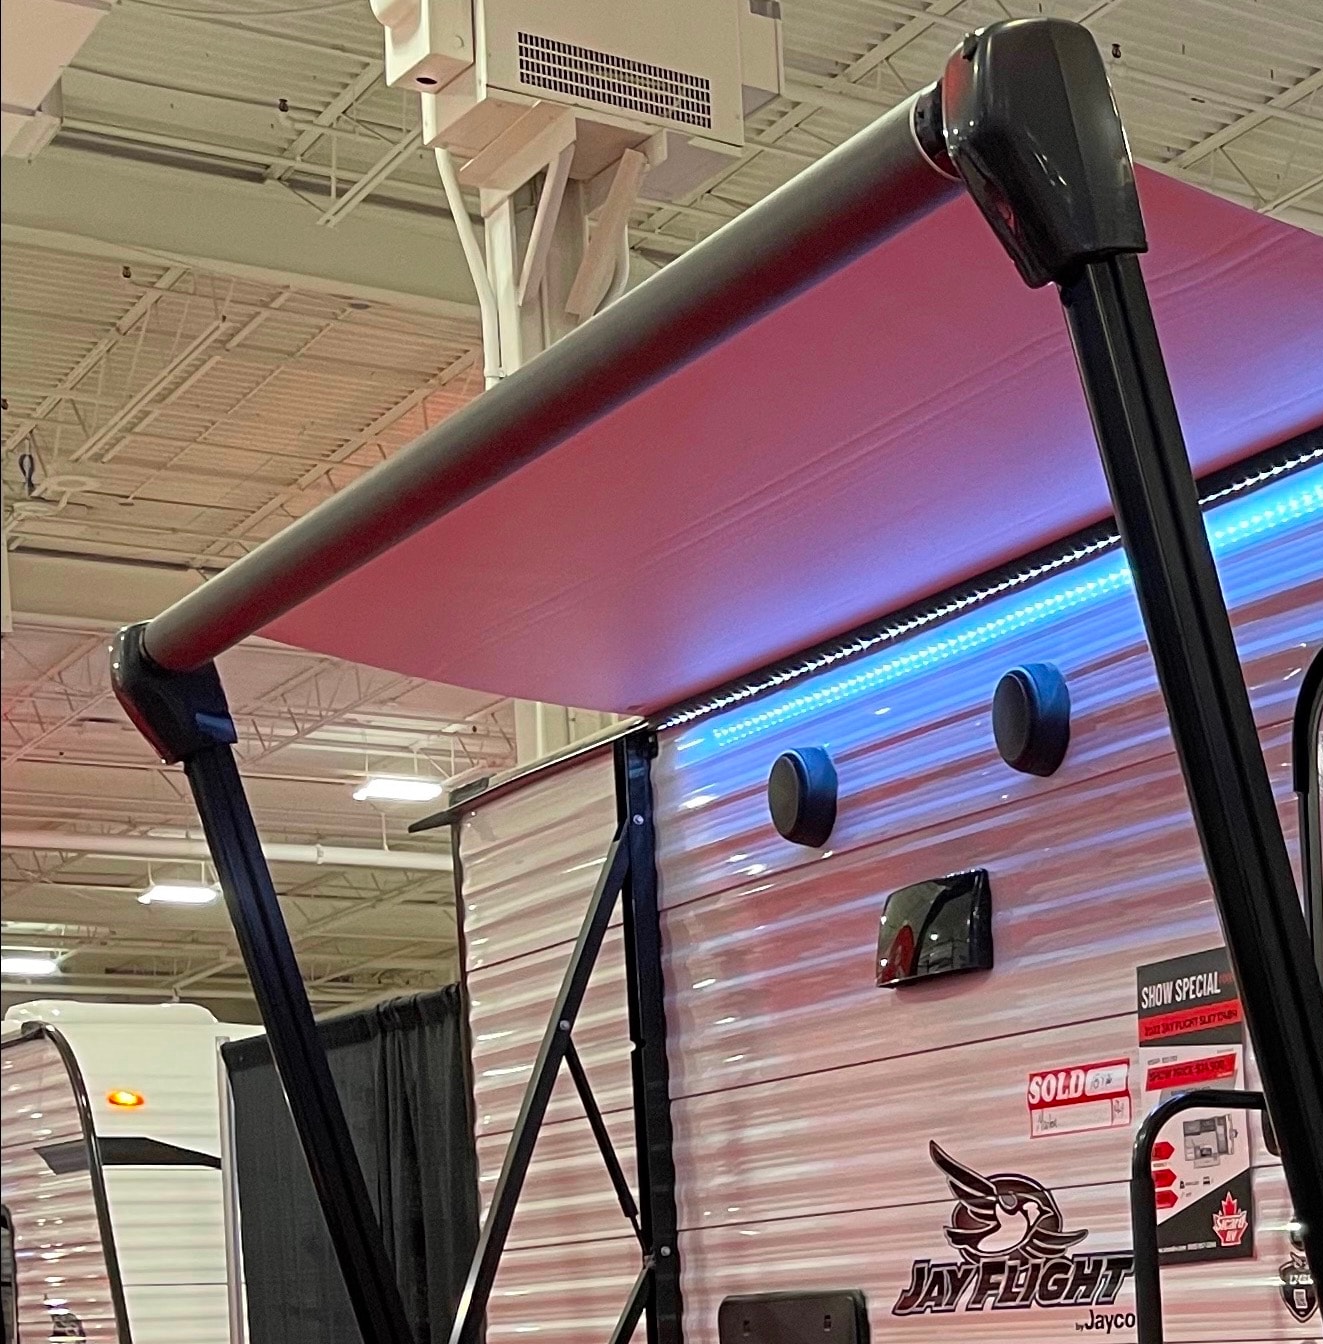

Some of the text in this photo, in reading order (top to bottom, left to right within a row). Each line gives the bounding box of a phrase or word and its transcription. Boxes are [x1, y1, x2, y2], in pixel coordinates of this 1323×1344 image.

[1141, 971, 1221, 1010] SHOW SPECIAL
[1028, 1068, 1085, 1105] SOLD
[892, 1250, 1136, 1316] JAY FLIGHT
[1076, 1309, 1136, 1333] by Jayco
